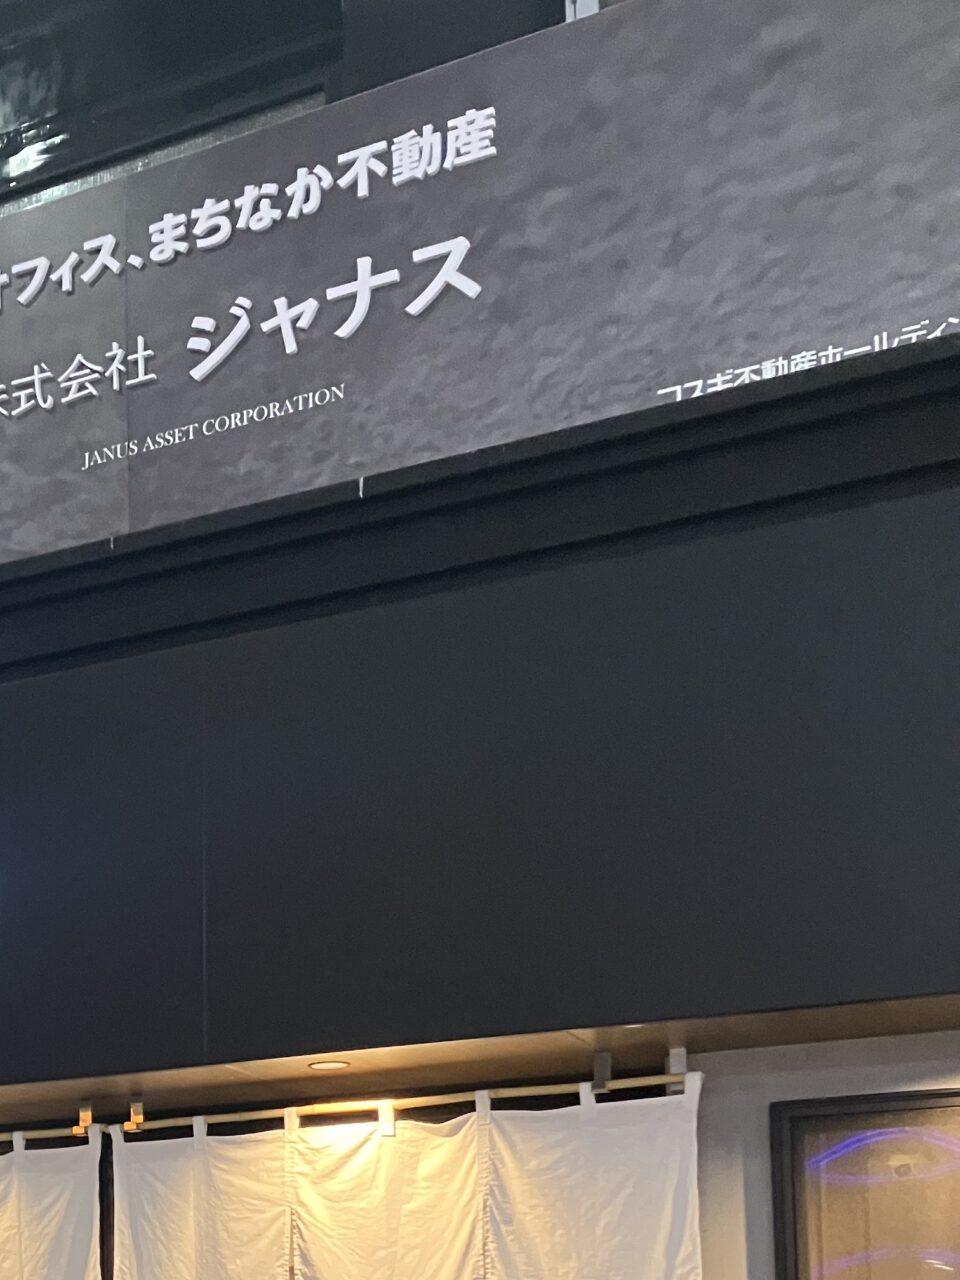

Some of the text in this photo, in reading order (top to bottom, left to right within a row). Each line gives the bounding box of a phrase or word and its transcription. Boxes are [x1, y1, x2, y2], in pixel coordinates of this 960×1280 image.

[186, 235, 483, 382] ジャナス
[81, 383, 346, 471] JANUS ASSET CORPORATION
